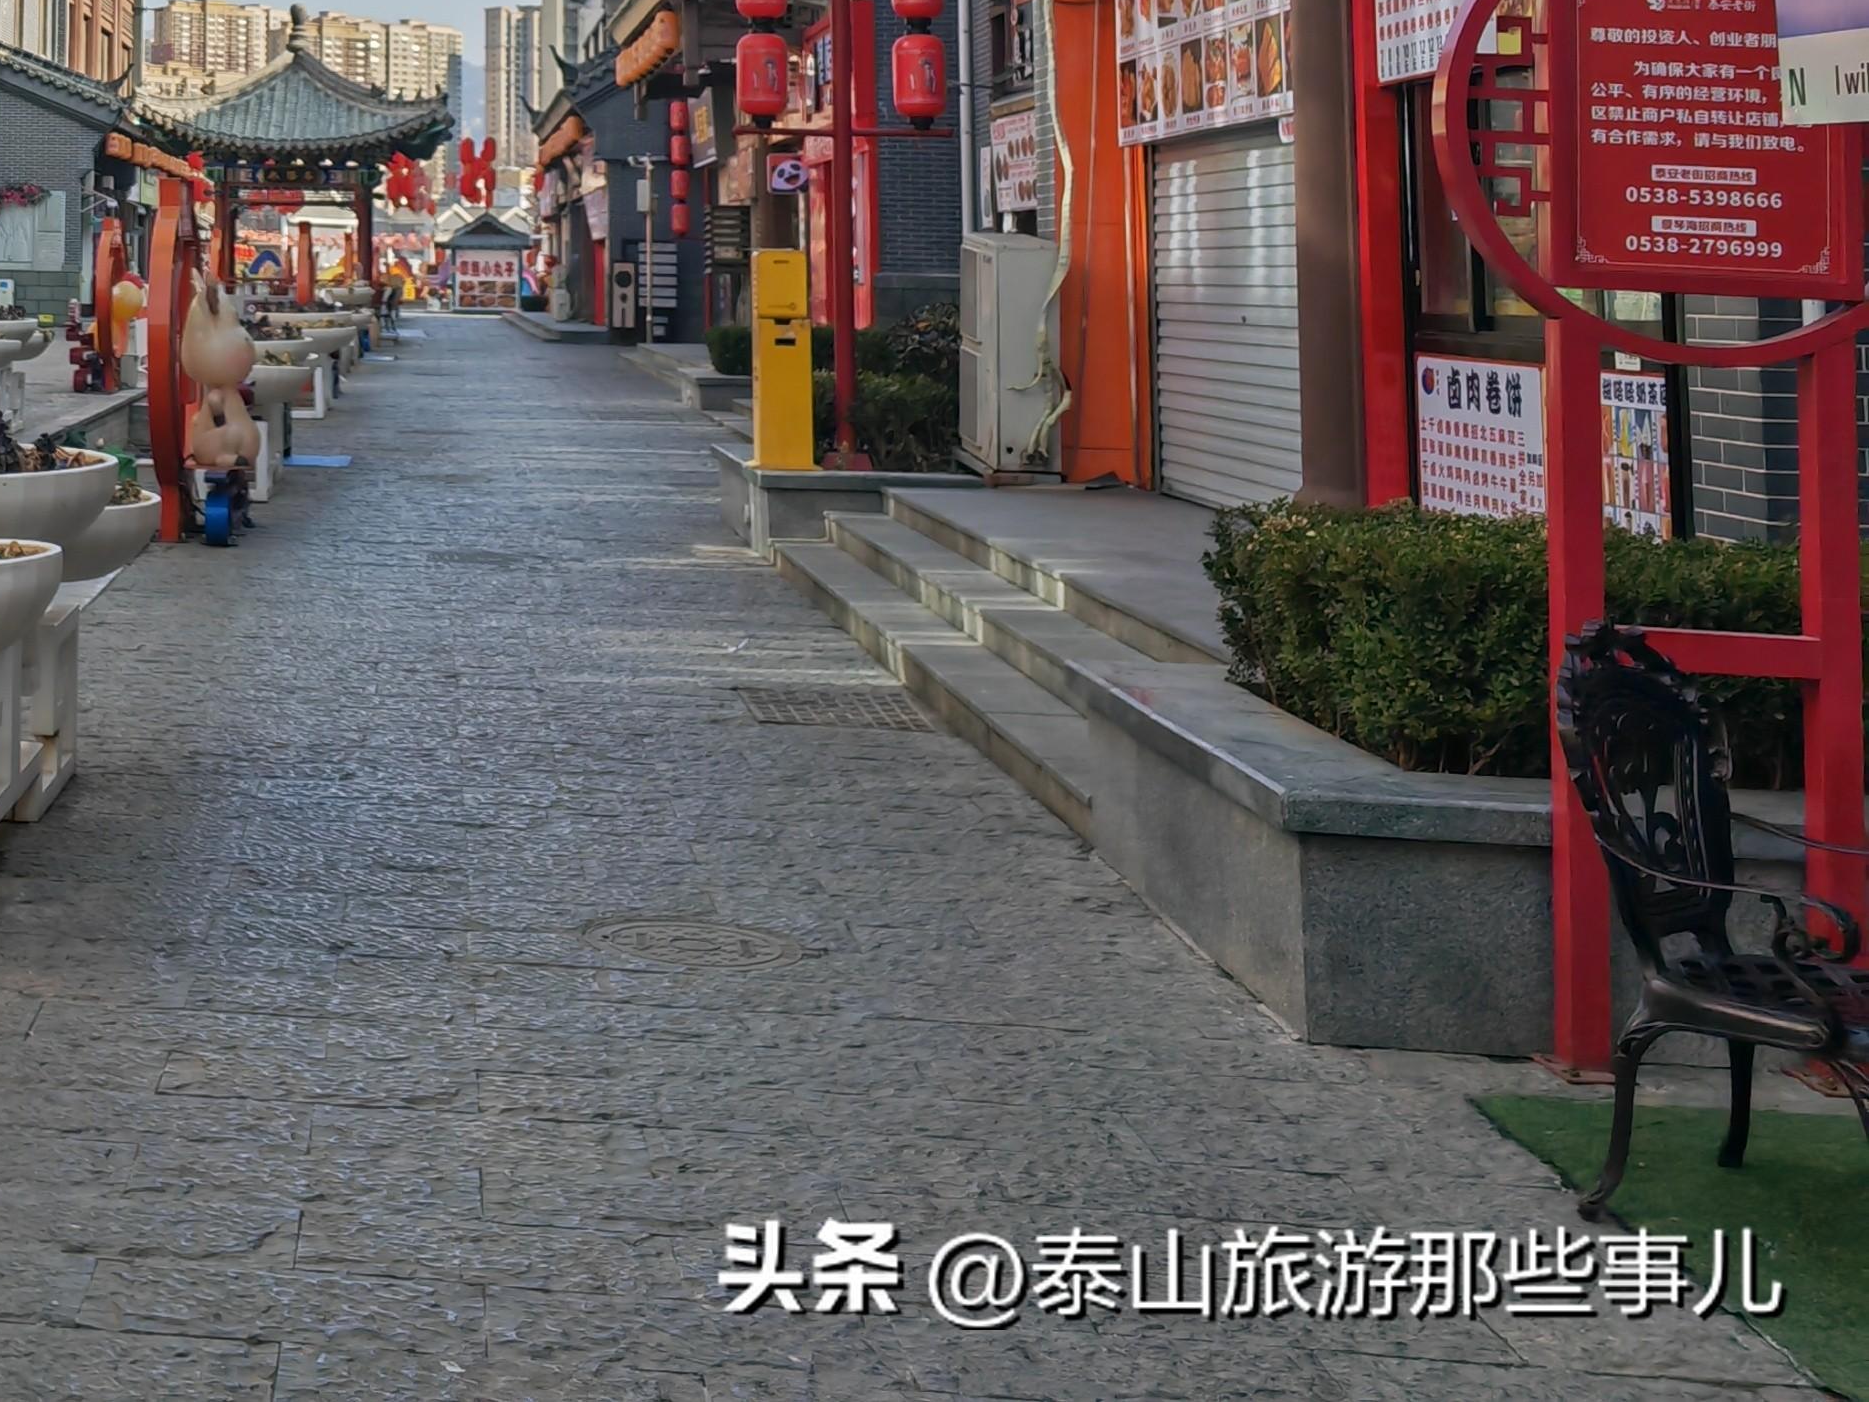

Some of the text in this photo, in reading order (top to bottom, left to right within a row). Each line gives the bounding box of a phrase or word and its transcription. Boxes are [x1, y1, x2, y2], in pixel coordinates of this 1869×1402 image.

[1590, 27, 1778, 49] 尊敬的投资人、创业者朋
[1591, 82, 1783, 105] 公平、有序的经营环境，
[1788, 67, 1807, 106] N
[1591, 105, 1813, 129] 区禁止商户私自转让店铺，
[1591, 129, 1805, 153] 有合作需求，请与我们致电。
[1655, 168, 1754, 183] 泰安老街招商热线
[1625, 186, 1783, 209] 0538-5398666
[1625, 235, 1783, 259] 0538-2796999
[1447, 366, 1522, 418] 卤肉卷饼
